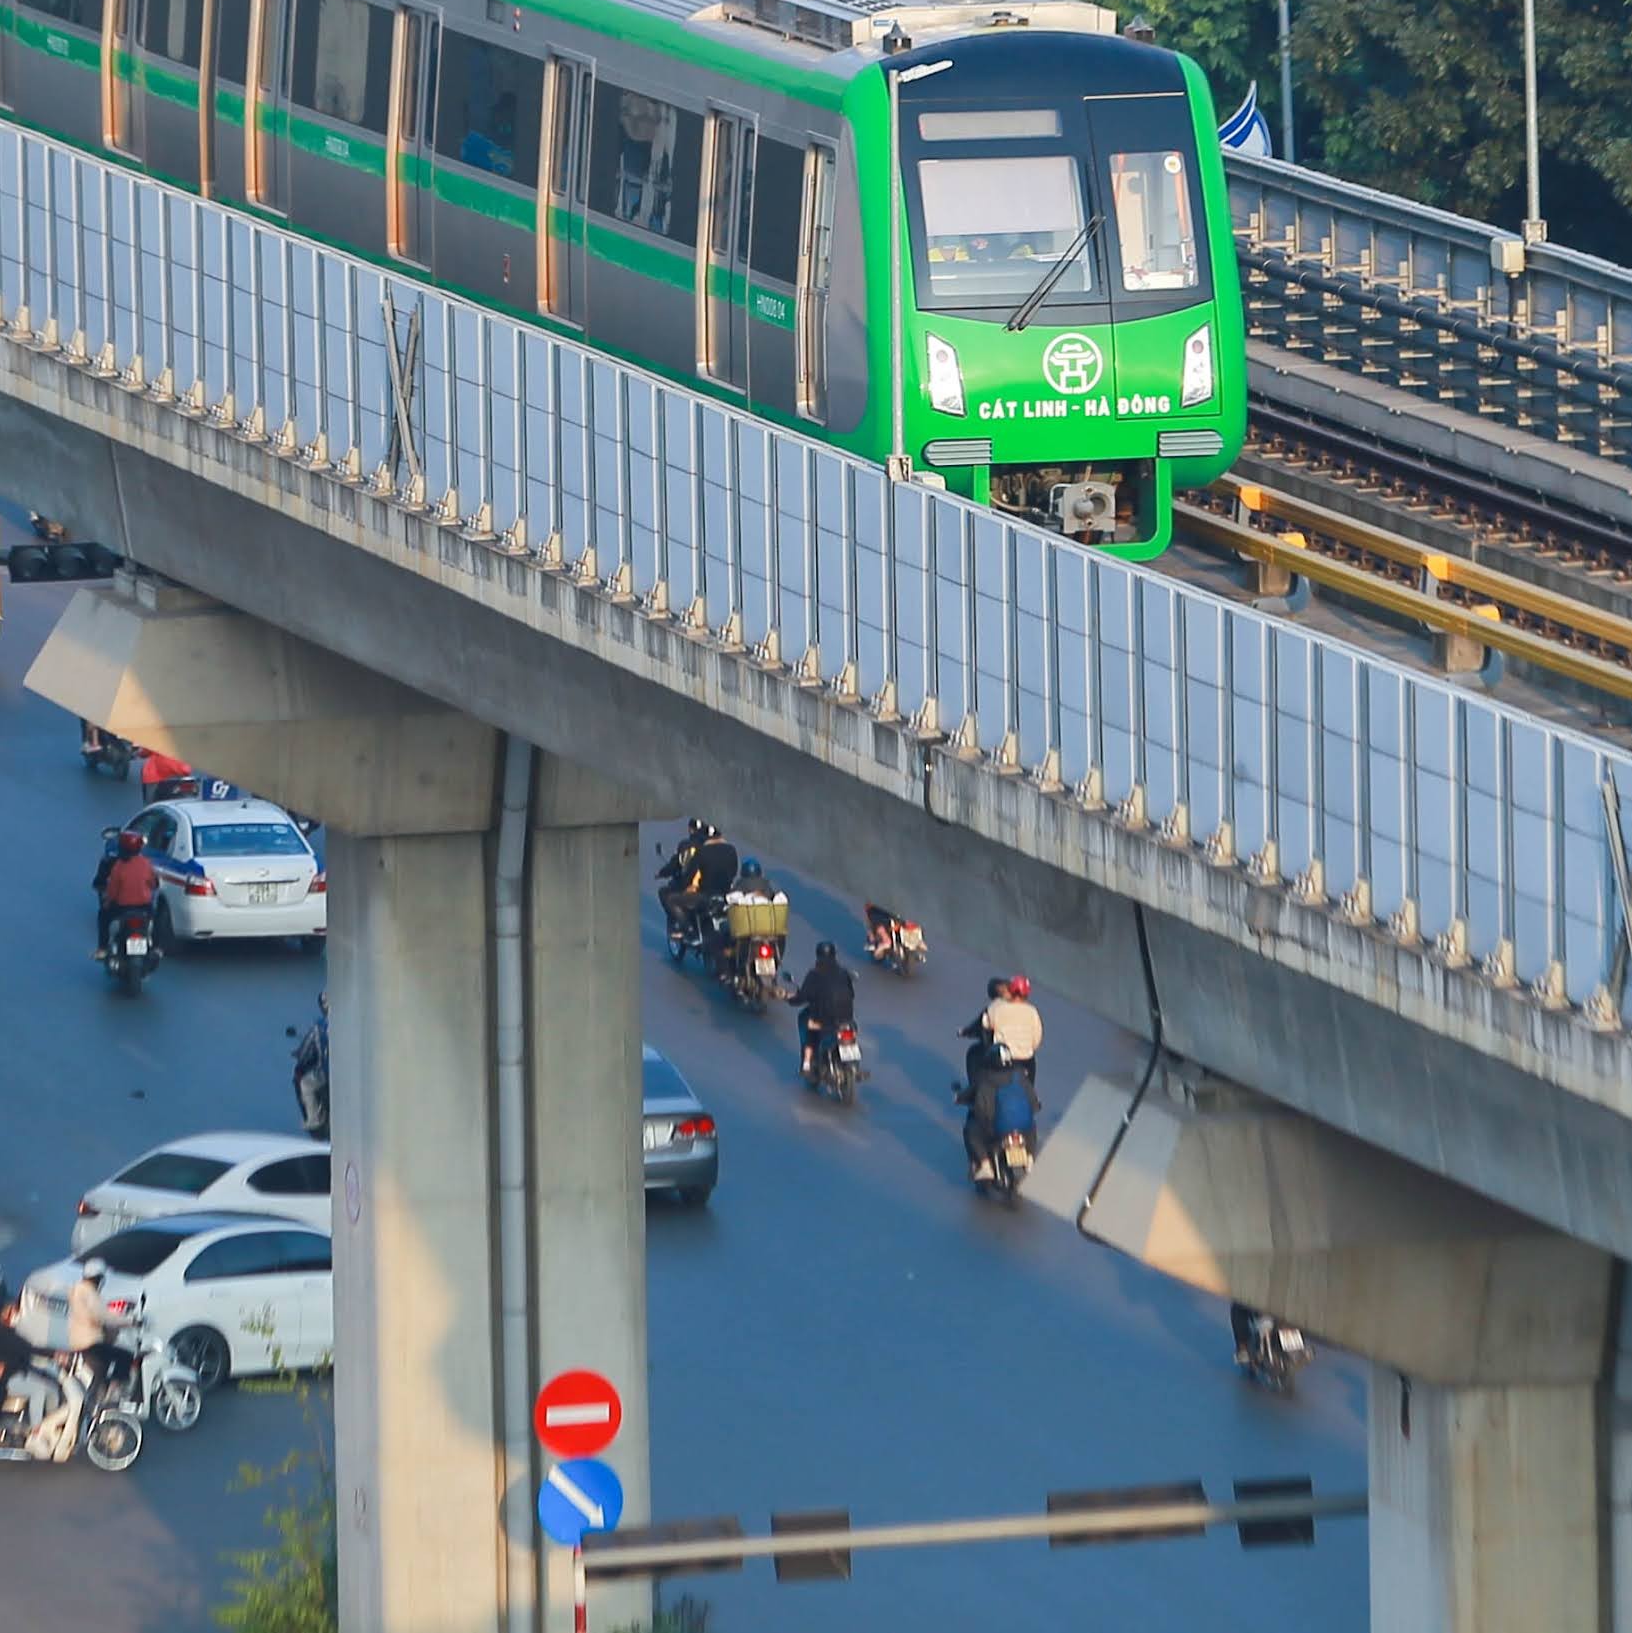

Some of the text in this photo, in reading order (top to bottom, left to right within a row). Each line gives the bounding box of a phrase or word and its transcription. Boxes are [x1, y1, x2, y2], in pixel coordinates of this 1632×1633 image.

[978, 398, 1018, 419] CÁT
[1023, 400, 1067, 418] LINH
[1084, 396, 1111, 417] HÀ
[1117, 394, 1171, 415] ĐÔNG
